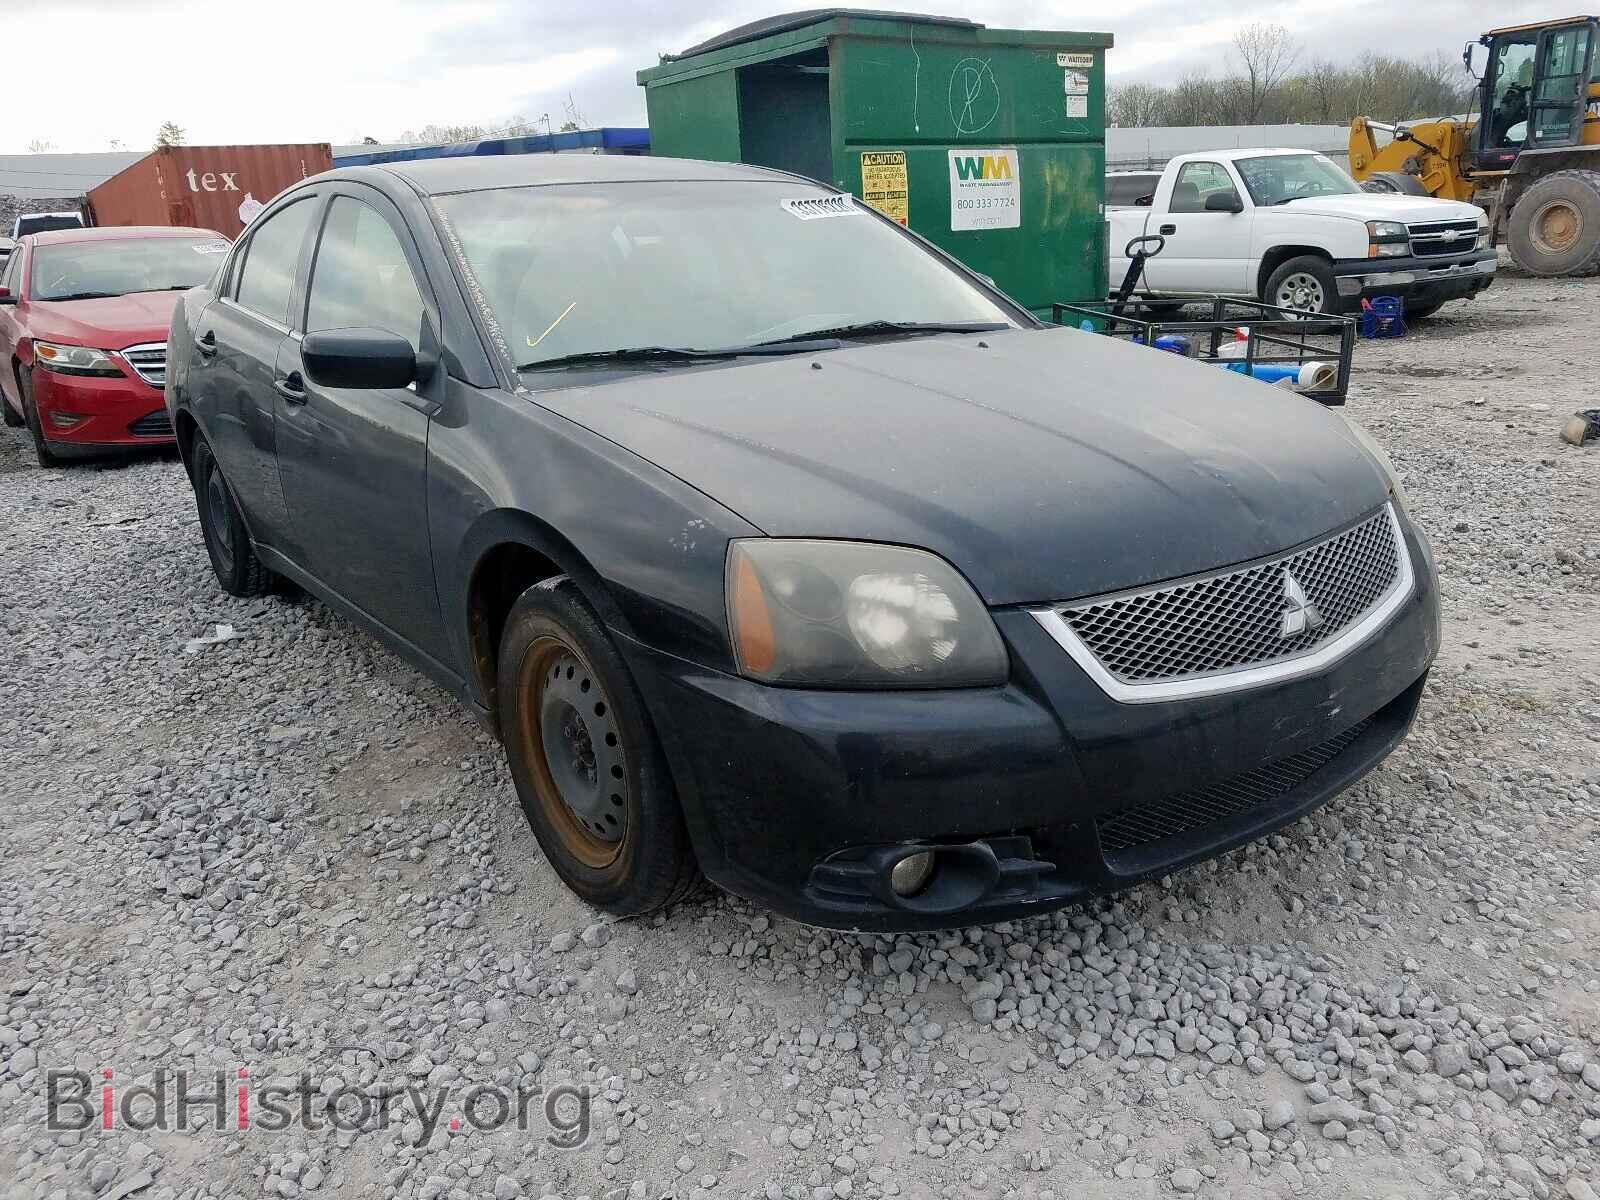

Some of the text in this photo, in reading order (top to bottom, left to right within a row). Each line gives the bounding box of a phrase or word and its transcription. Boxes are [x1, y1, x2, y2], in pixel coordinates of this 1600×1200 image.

[870, 153, 904, 165] CAUTION
[954, 155, 1012, 180] WM
[186, 167, 240, 192] tex
[957, 197, 1015, 209] 800 333 7724
